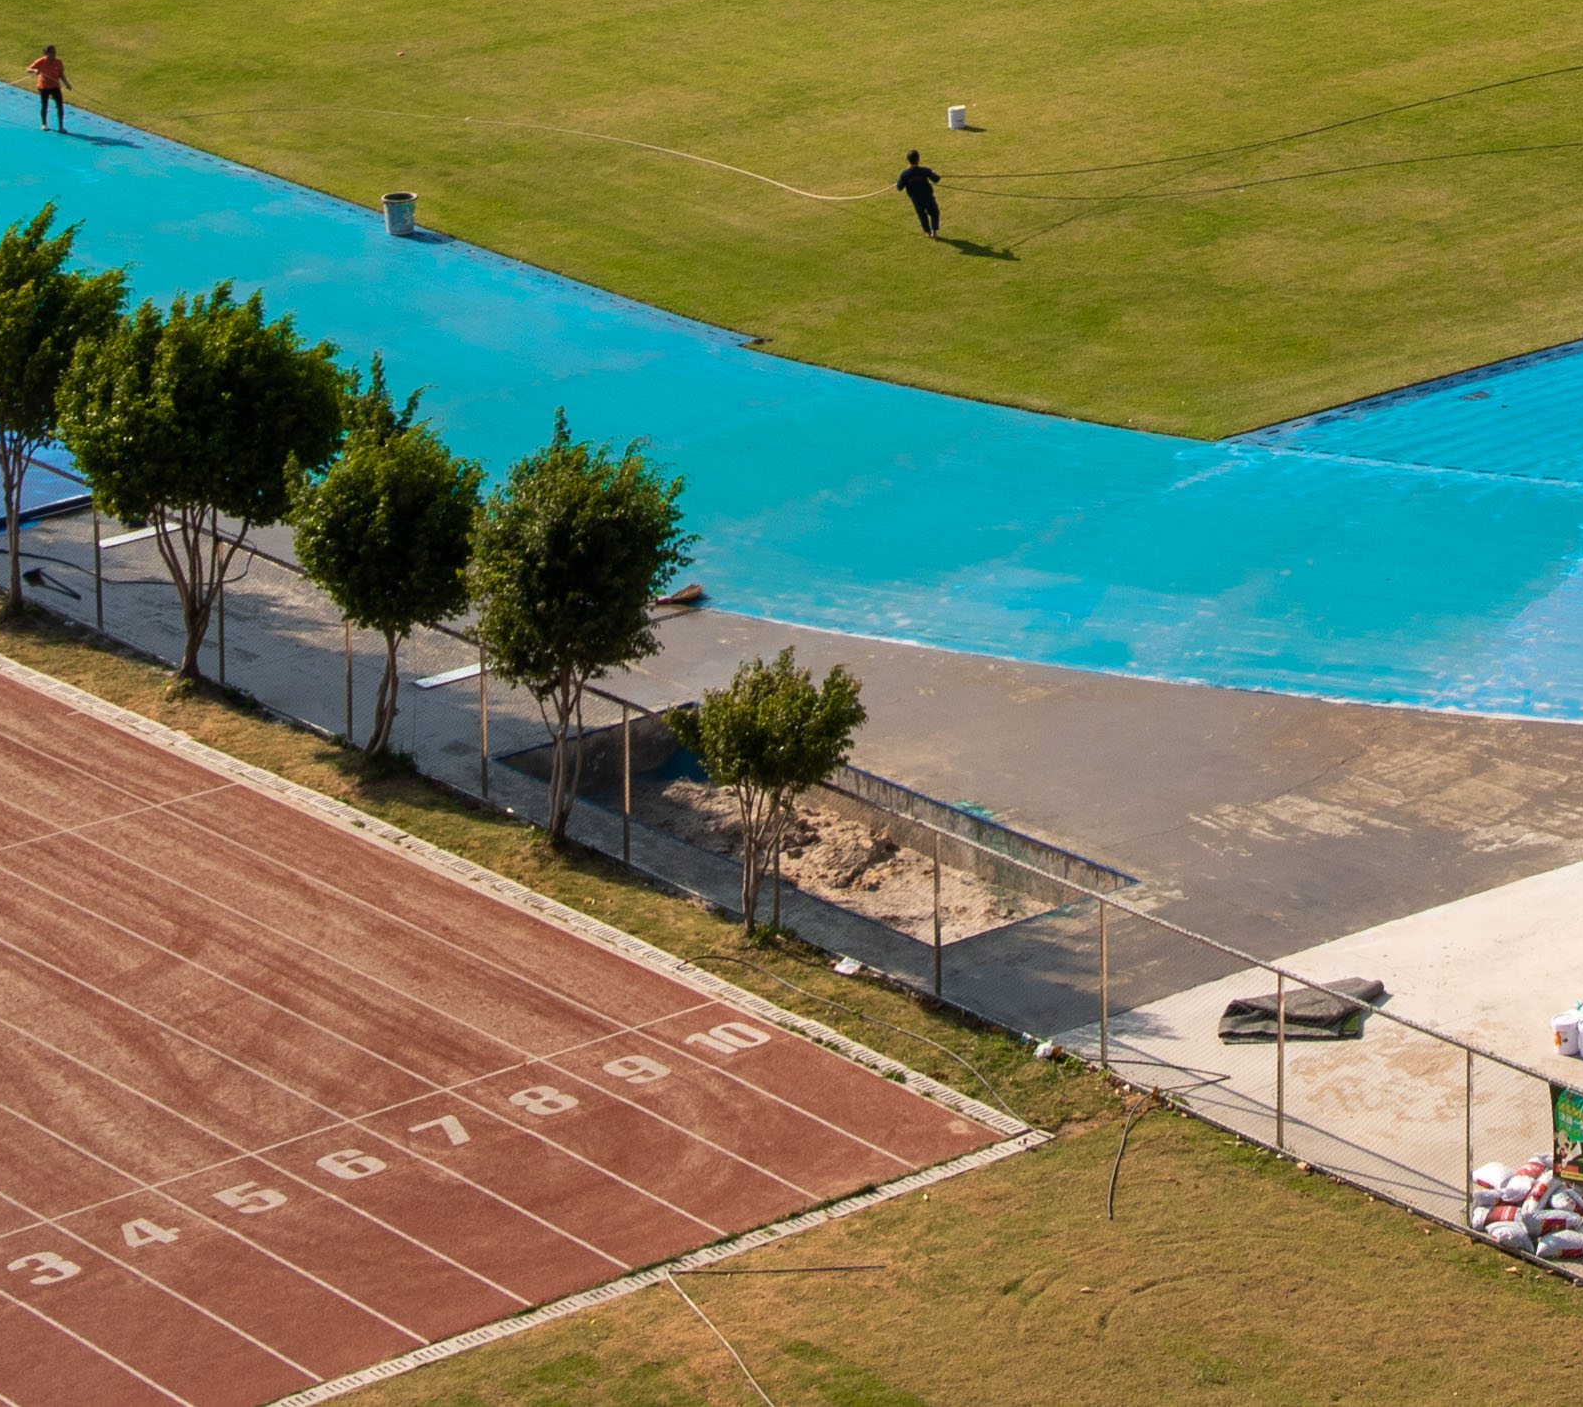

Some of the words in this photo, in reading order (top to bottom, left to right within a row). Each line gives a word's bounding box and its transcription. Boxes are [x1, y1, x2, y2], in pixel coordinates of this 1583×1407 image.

[6, 1252, 82, 1287] 3
[120, 1217, 181, 1251] 4
[211, 1182, 288, 1215] 5
[316, 1149, 387, 1182] 6
[409, 1115, 471, 1147] 7
[508, 1085, 579, 1117] 8
[602, 1055, 672, 1085] 9
[684, 1022, 772, 1056] 10
